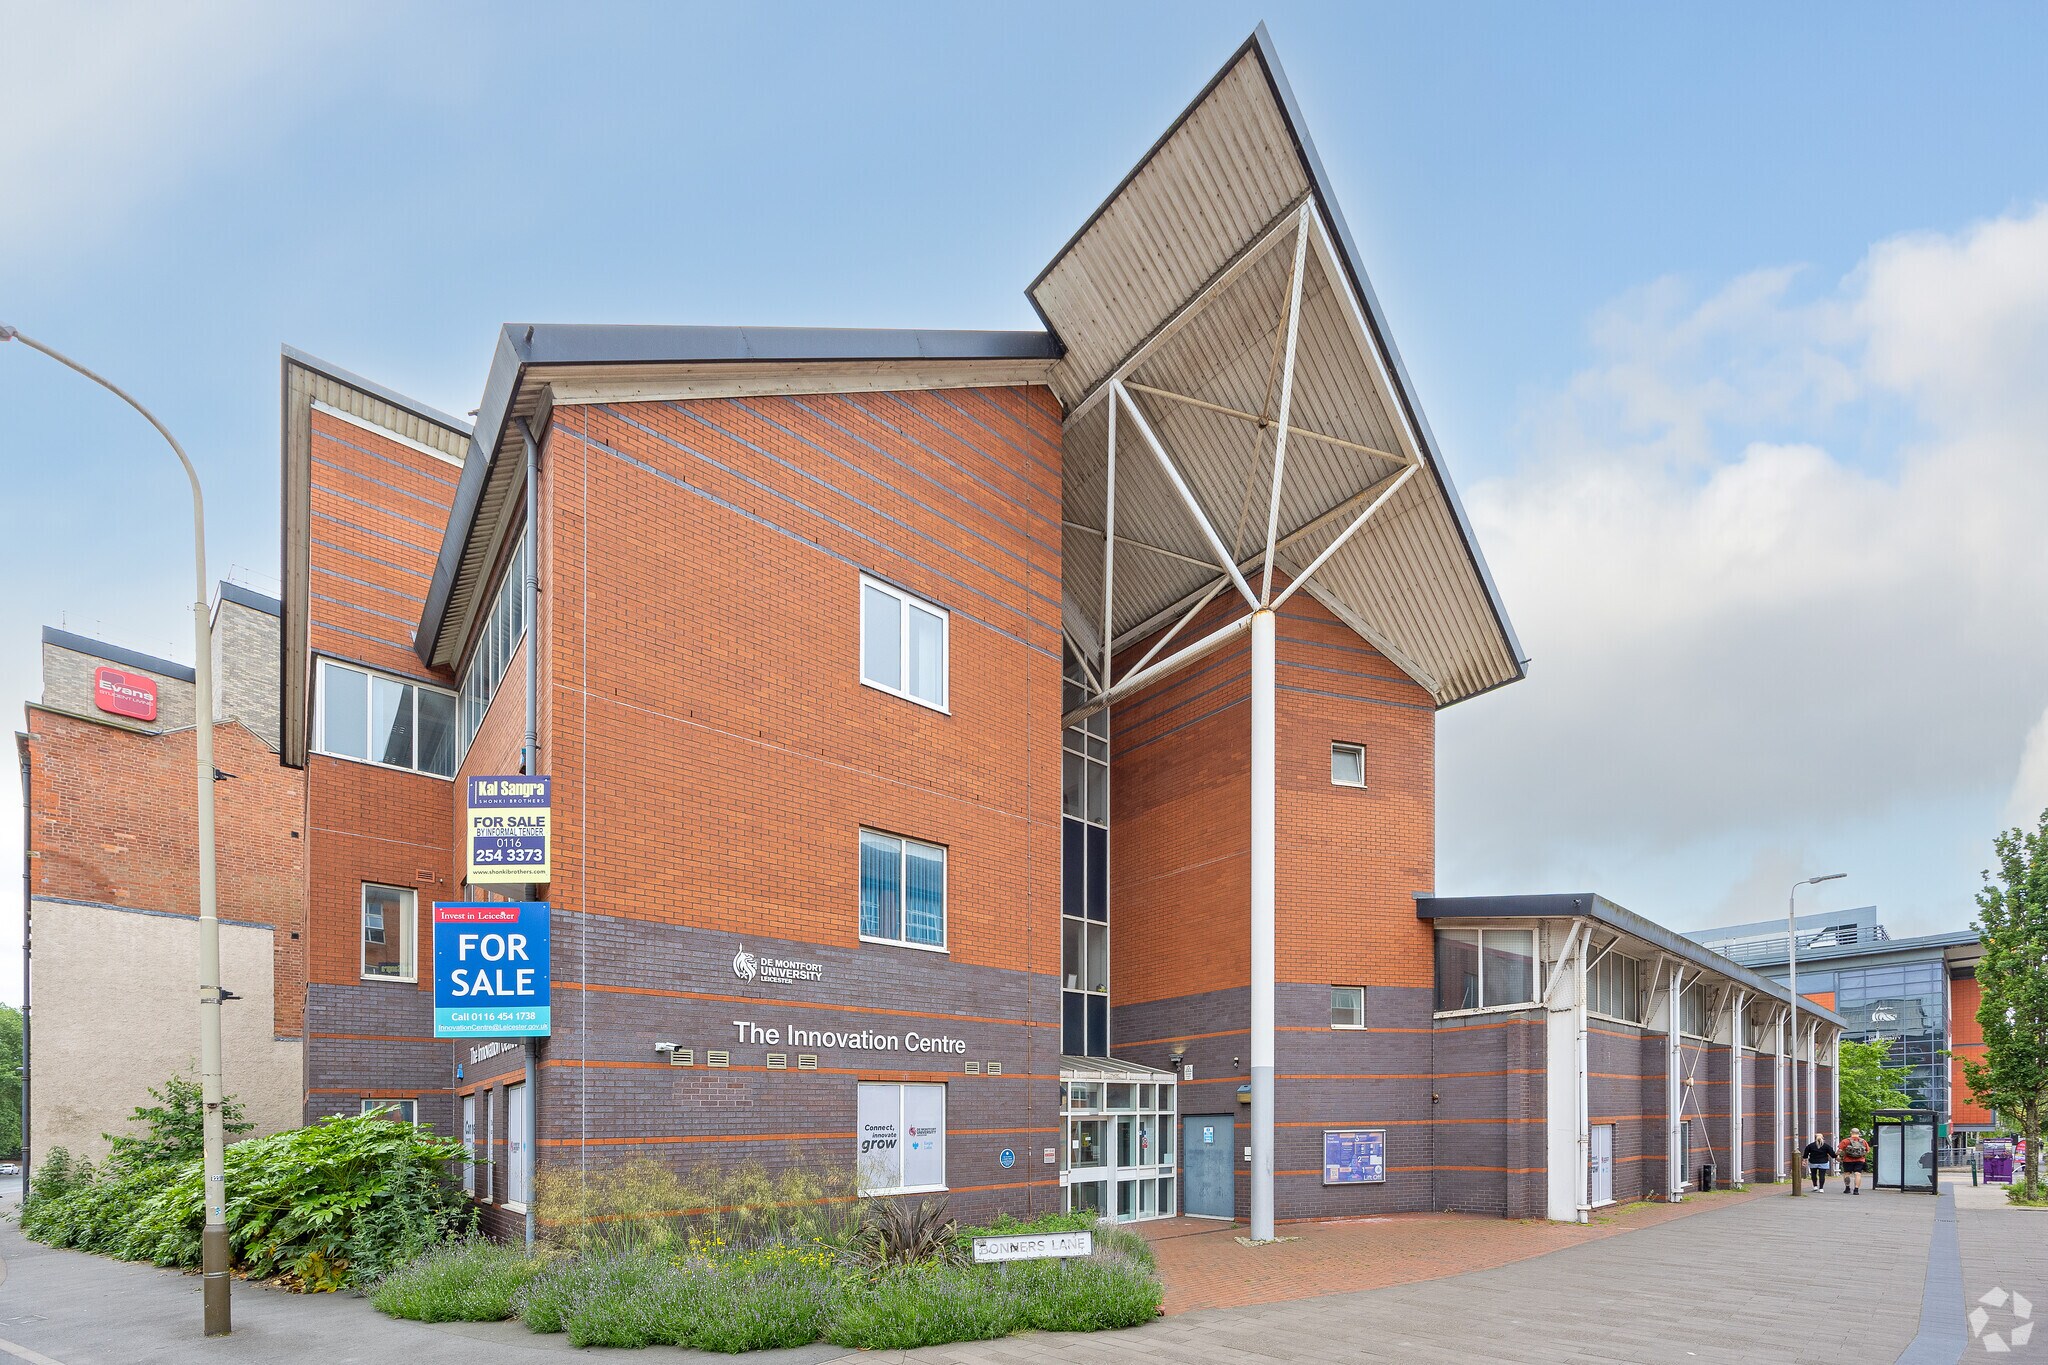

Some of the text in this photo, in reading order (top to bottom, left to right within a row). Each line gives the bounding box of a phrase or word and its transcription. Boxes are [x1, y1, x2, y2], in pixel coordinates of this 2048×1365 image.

[99, 680, 153, 701] Evans
[99, 690, 154, 706] STUDENT LIVING
[478, 780, 545, 798] Kal Sangra
[474, 816, 546, 828] FOR SALE
[476, 827, 544, 837] BY INFORMAL TENDER
[496, 838, 522, 848] 0116
[475, 848, 543, 862] 254 3373
[441, 911, 515, 920] Invest in Leicester
[459, 933, 530, 962] FOR
[760, 957, 823, 972] DE MONTFORT
[760, 966, 823, 982] UNIVERSITY
[760, 975, 793, 985] LEICESTER
[451, 968, 536, 997] SALE
[451, 1011, 536, 1021] Call 0116 454 1738
[733, 1021, 966, 1054] The Innovation Centre
[864, 1124, 895, 1132] Connect,
[861, 1139, 898, 1154] grow
[978, 1238, 1085, 1255] BONNERS LANE
